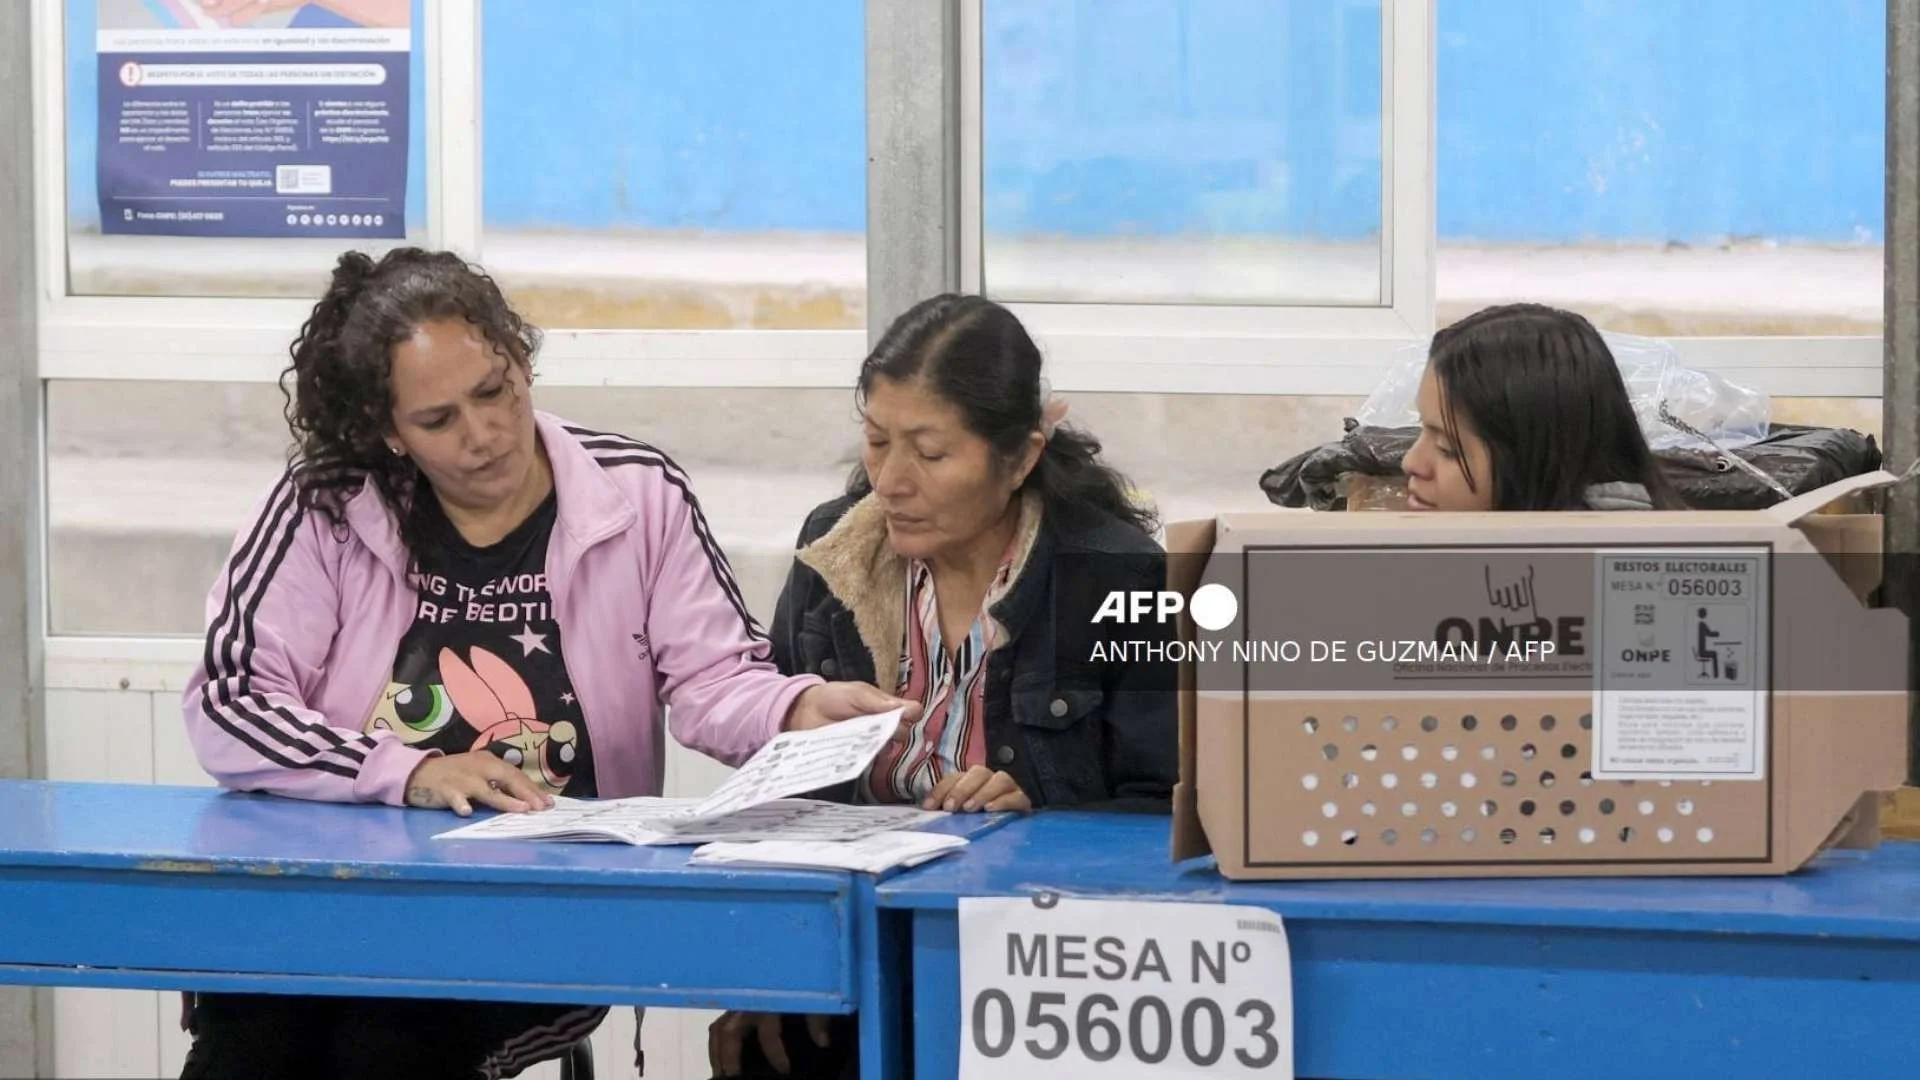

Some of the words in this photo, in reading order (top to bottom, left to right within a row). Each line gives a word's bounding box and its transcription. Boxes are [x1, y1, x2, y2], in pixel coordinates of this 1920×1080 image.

[1613, 561, 1660, 573] RESTOS
[1665, 561, 1748, 573] ELECTORALES
[1611, 581, 1643, 592] MESA
[1668, 578, 1743, 597] 056003
[1434, 616, 1585, 656] ONPE
[1621, 649, 1671, 663] ONPE
[1006, 932, 1172, 983] MESA
[972, 988, 1279, 1069] 056003
